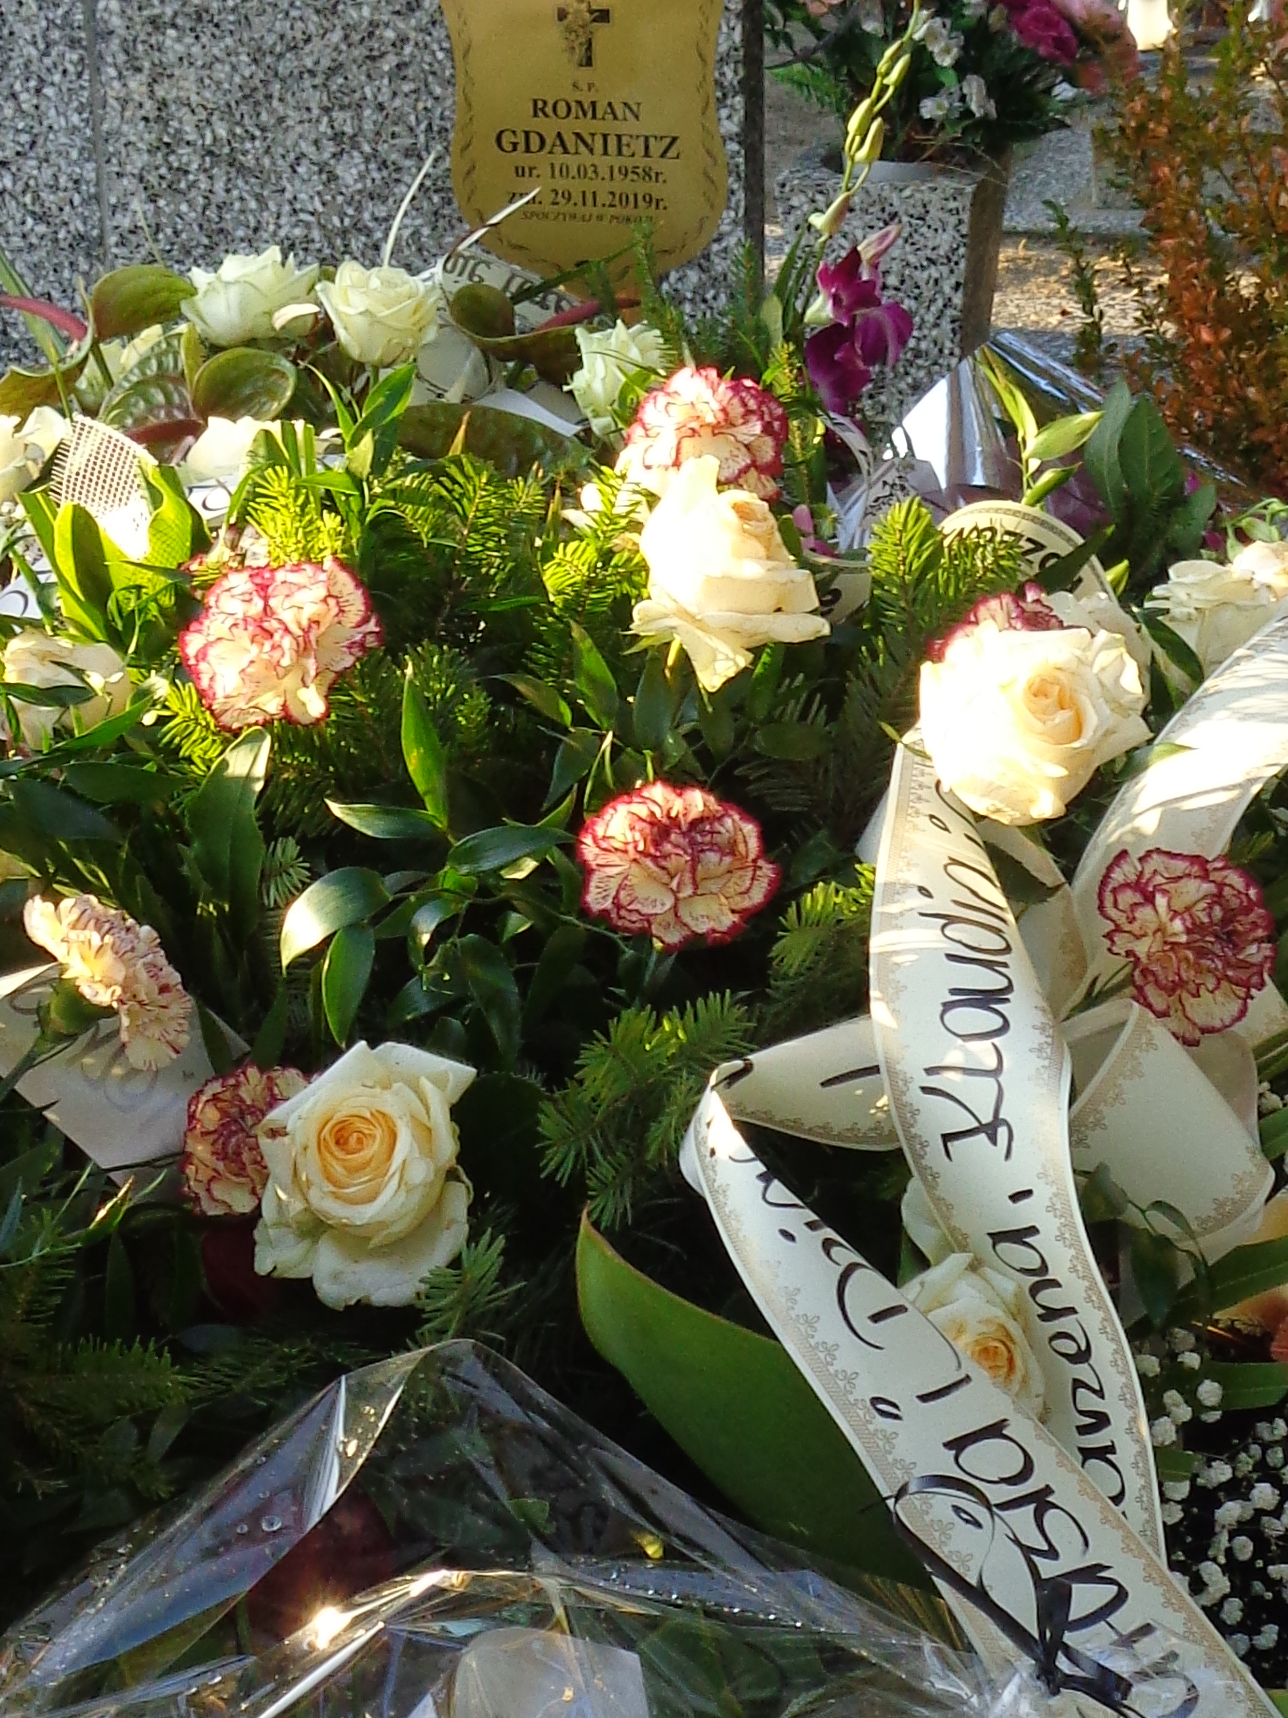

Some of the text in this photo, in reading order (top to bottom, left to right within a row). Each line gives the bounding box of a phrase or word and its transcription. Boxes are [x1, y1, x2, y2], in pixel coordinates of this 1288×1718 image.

[531, 98, 643, 122] ROMAN
[495, 128, 681, 161] GDANIETZ
[514, 162, 668, 185] ur. 10.03.1958r.
[550, 188, 668, 212] 29.11.2019r.
[987, 1186, 1130, 1523] arzena,
